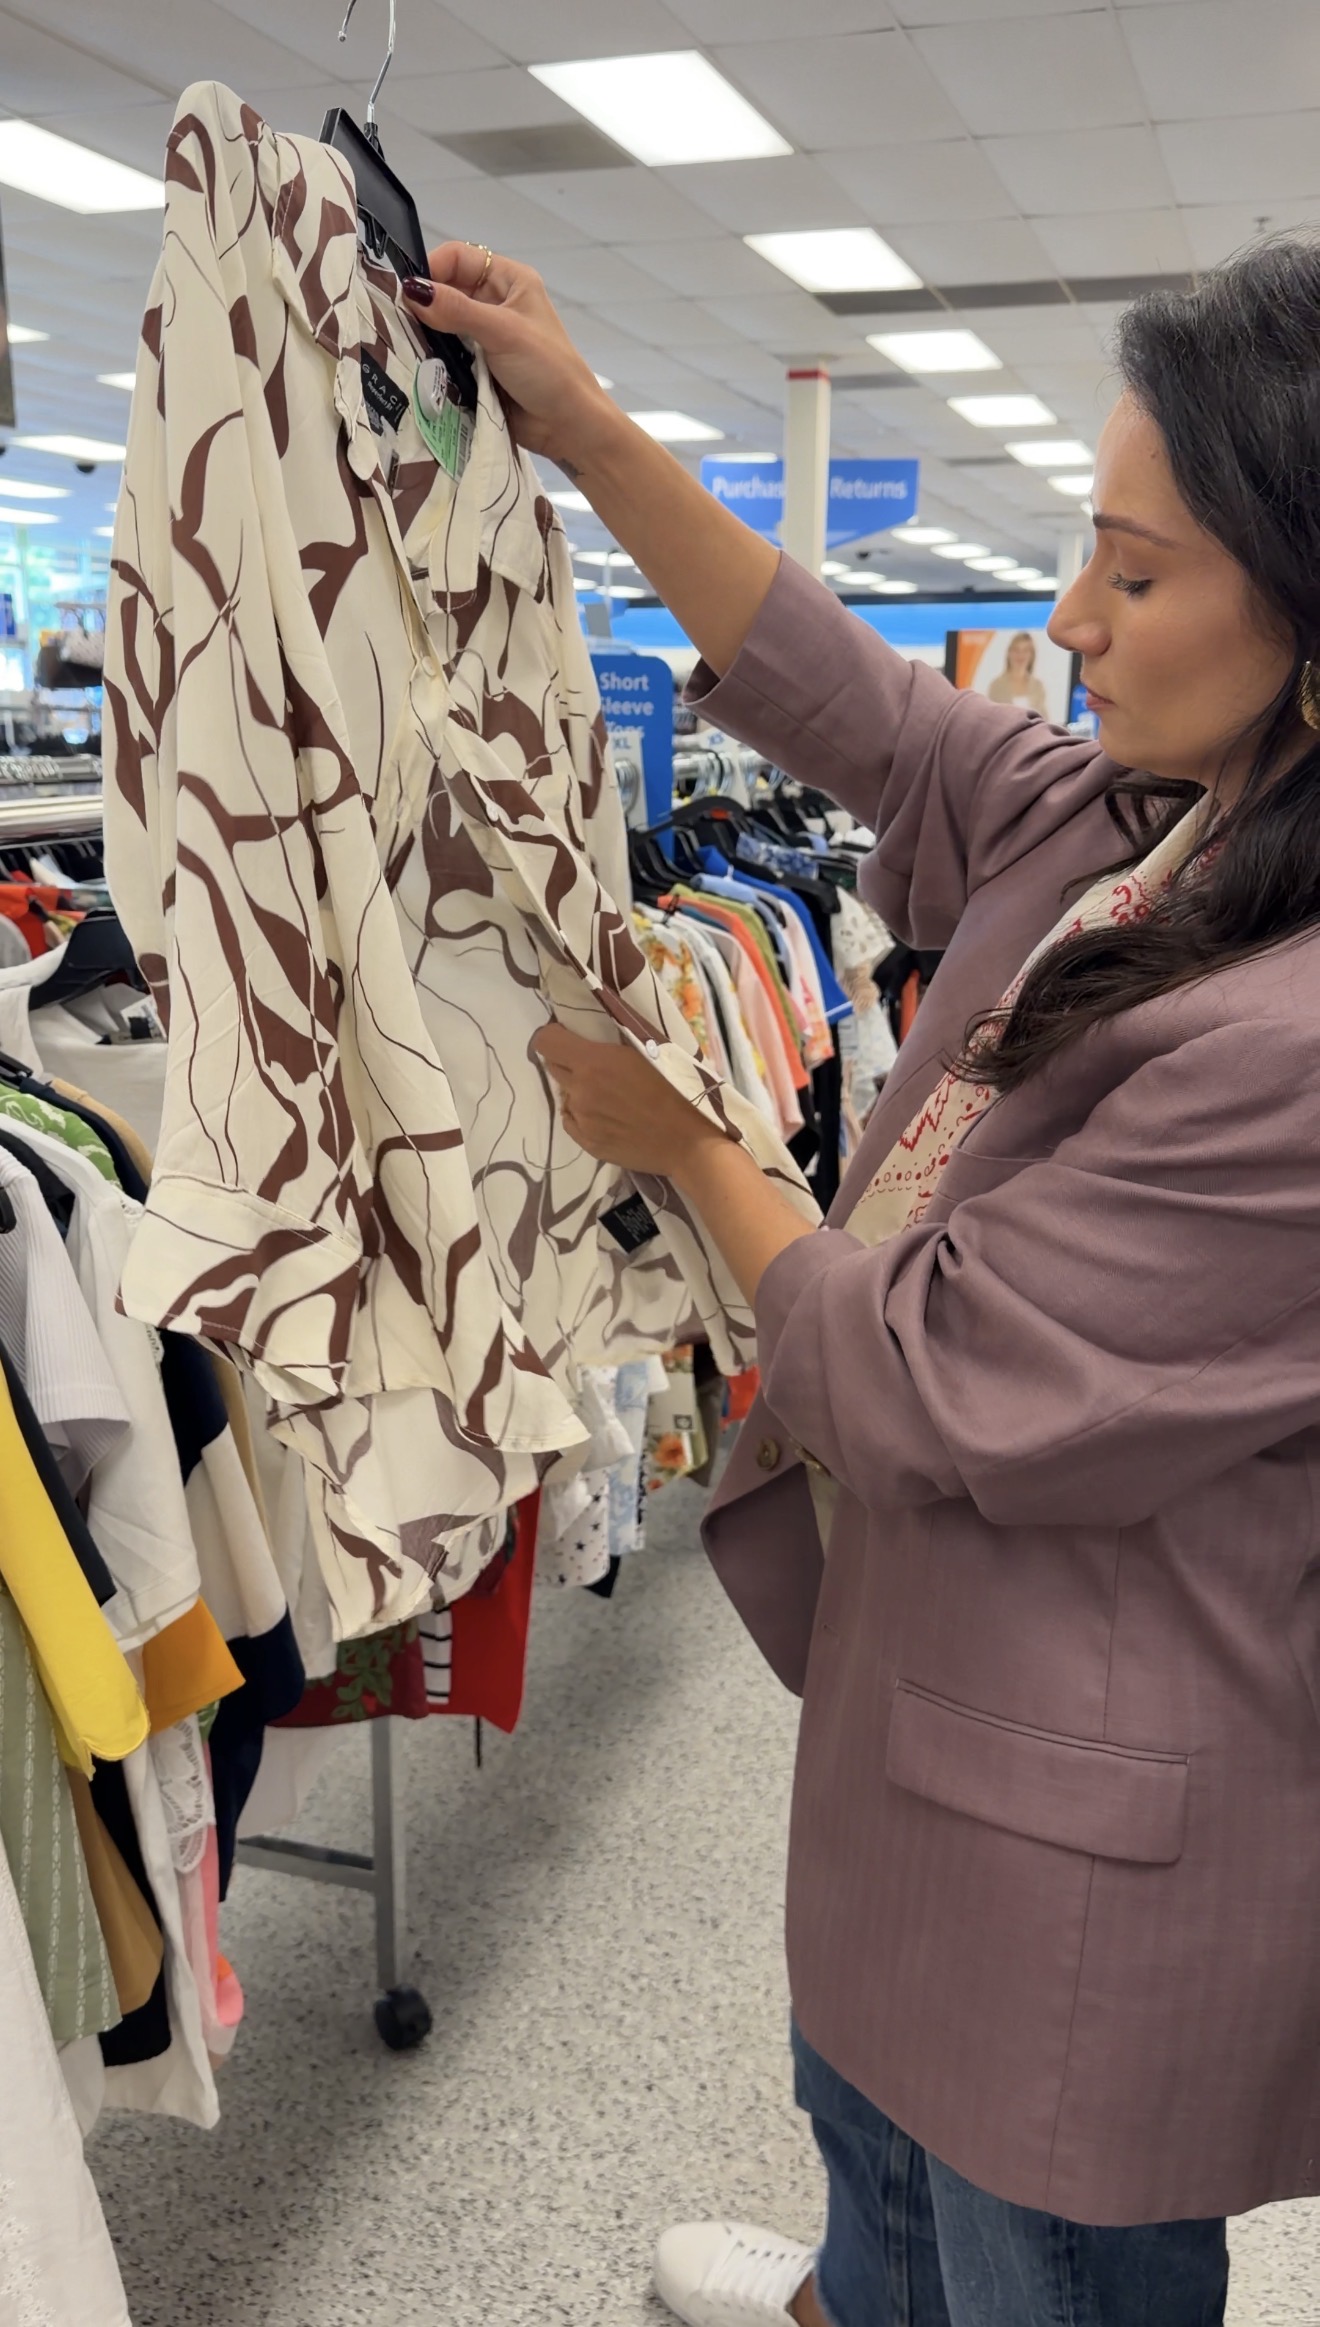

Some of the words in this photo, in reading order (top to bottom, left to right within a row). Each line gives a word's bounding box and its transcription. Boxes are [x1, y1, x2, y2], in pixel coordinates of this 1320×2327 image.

[712, 475, 785, 499] Purchas
[829, 477, 908, 499] Returns
[600, 672, 649, 691] Short
[612, 737, 632, 749] XL
